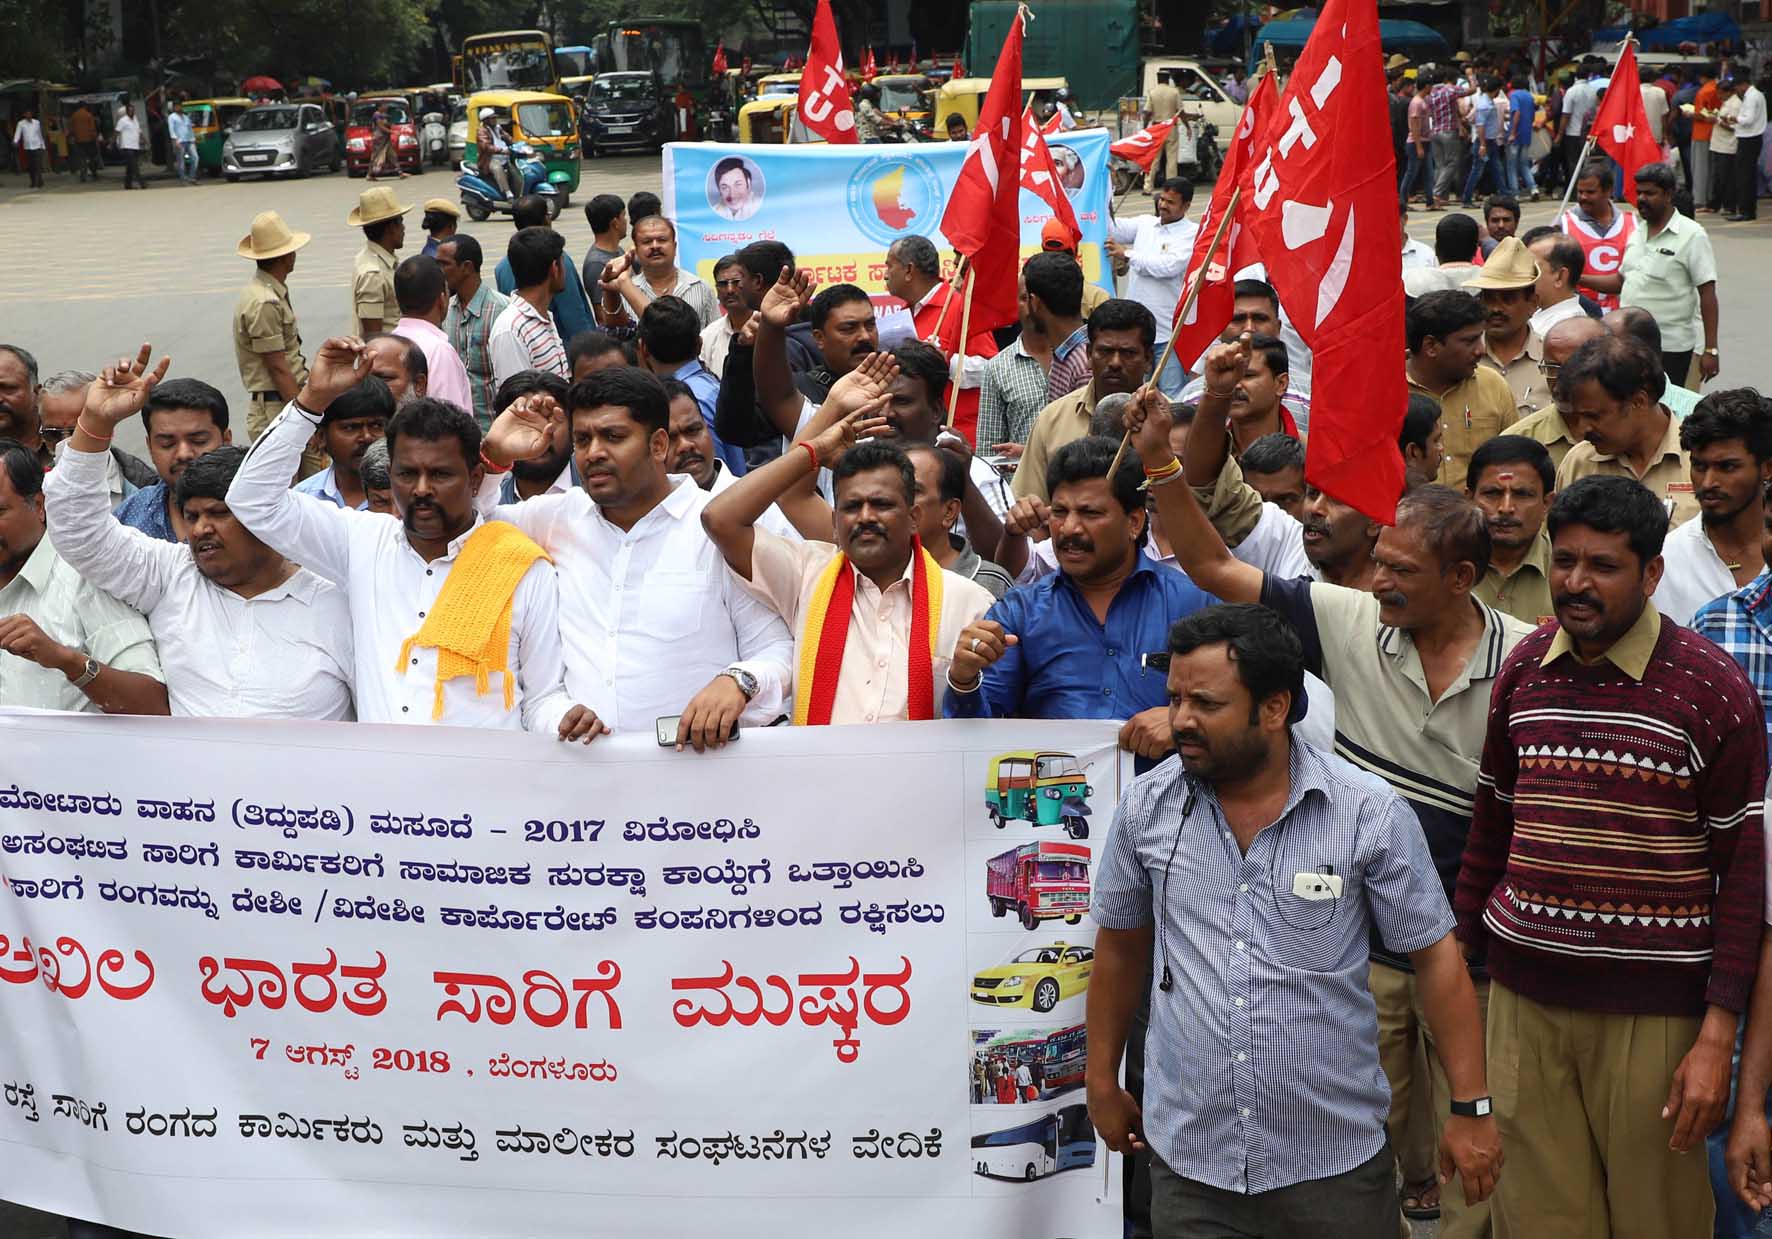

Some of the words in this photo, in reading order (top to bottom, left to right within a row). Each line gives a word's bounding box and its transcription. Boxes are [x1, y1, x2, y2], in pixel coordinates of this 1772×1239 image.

[0, 785, 121, 815] ಮೋಟಾರು
[137, 799, 215, 822] ವಾಹನ
[232, 799, 353, 838] (ತಿದ್ದುಪಡಿ)
[370, 812, 472, 838] ಮಸೂದೆ
[525, 820, 605, 842] 2017
[623, 817, 760, 842] ವಿರೋಧಿಸಿ
[2, 832, 127, 859] ಅಸಂಘಟಿತ
[143, 843, 219, 866] ಸಾರಿಗೆ
[235, 851, 384, 877] ಕಾರ್ಮಿಕರಿಗೆ
[400, 861, 531, 884] ಸಾಮಾಜಿಕ
[548, 864, 646, 897] ಸುರಕ್ಷಾ
[663, 859, 770, 895] ಕಾಯ್ದೆಗೆ
[789, 858, 924, 888] ಒತ್ತಾಯಿಸಿ
[9, 875, 83, 899] ಸಾರಿಗೆ
[99, 881, 219, 920] ರಂಗವನ್ನು
[635, 903, 822, 929] ಕಂಪನಿಗಳಿಂದ
[840, 900, 944, 935] ರಕ್ಷಿಸಲು
[198, 947, 388, 1018] ಭಾರತ
[434, 960, 621, 1029] ಸಾರಿಗೆ
[672, 957, 912, 1063] ಮುಷ್ಕರ
[250, 1037, 270, 1060] 7
[373, 1048, 450, 1072] 2018
[490, 1054, 616, 1081] ಬೆಂಗಳೂರು
[52, 1095, 108, 1131] ಸಾರಿಗೆ
[126, 1107, 217, 1137] ರಂಗದ
[239, 1113, 383, 1144] ಕಾರ್ಮಿಕರು
[403, 1120, 479, 1161] ಮತ್ತು
[496, 1125, 634, 1157] ಮಾಲೀಕರ
[656, 1130, 831, 1165] ಸಂಘಟನೆಗಳ
[853, 1128, 942, 1158] ವೇದಿಕೆ
